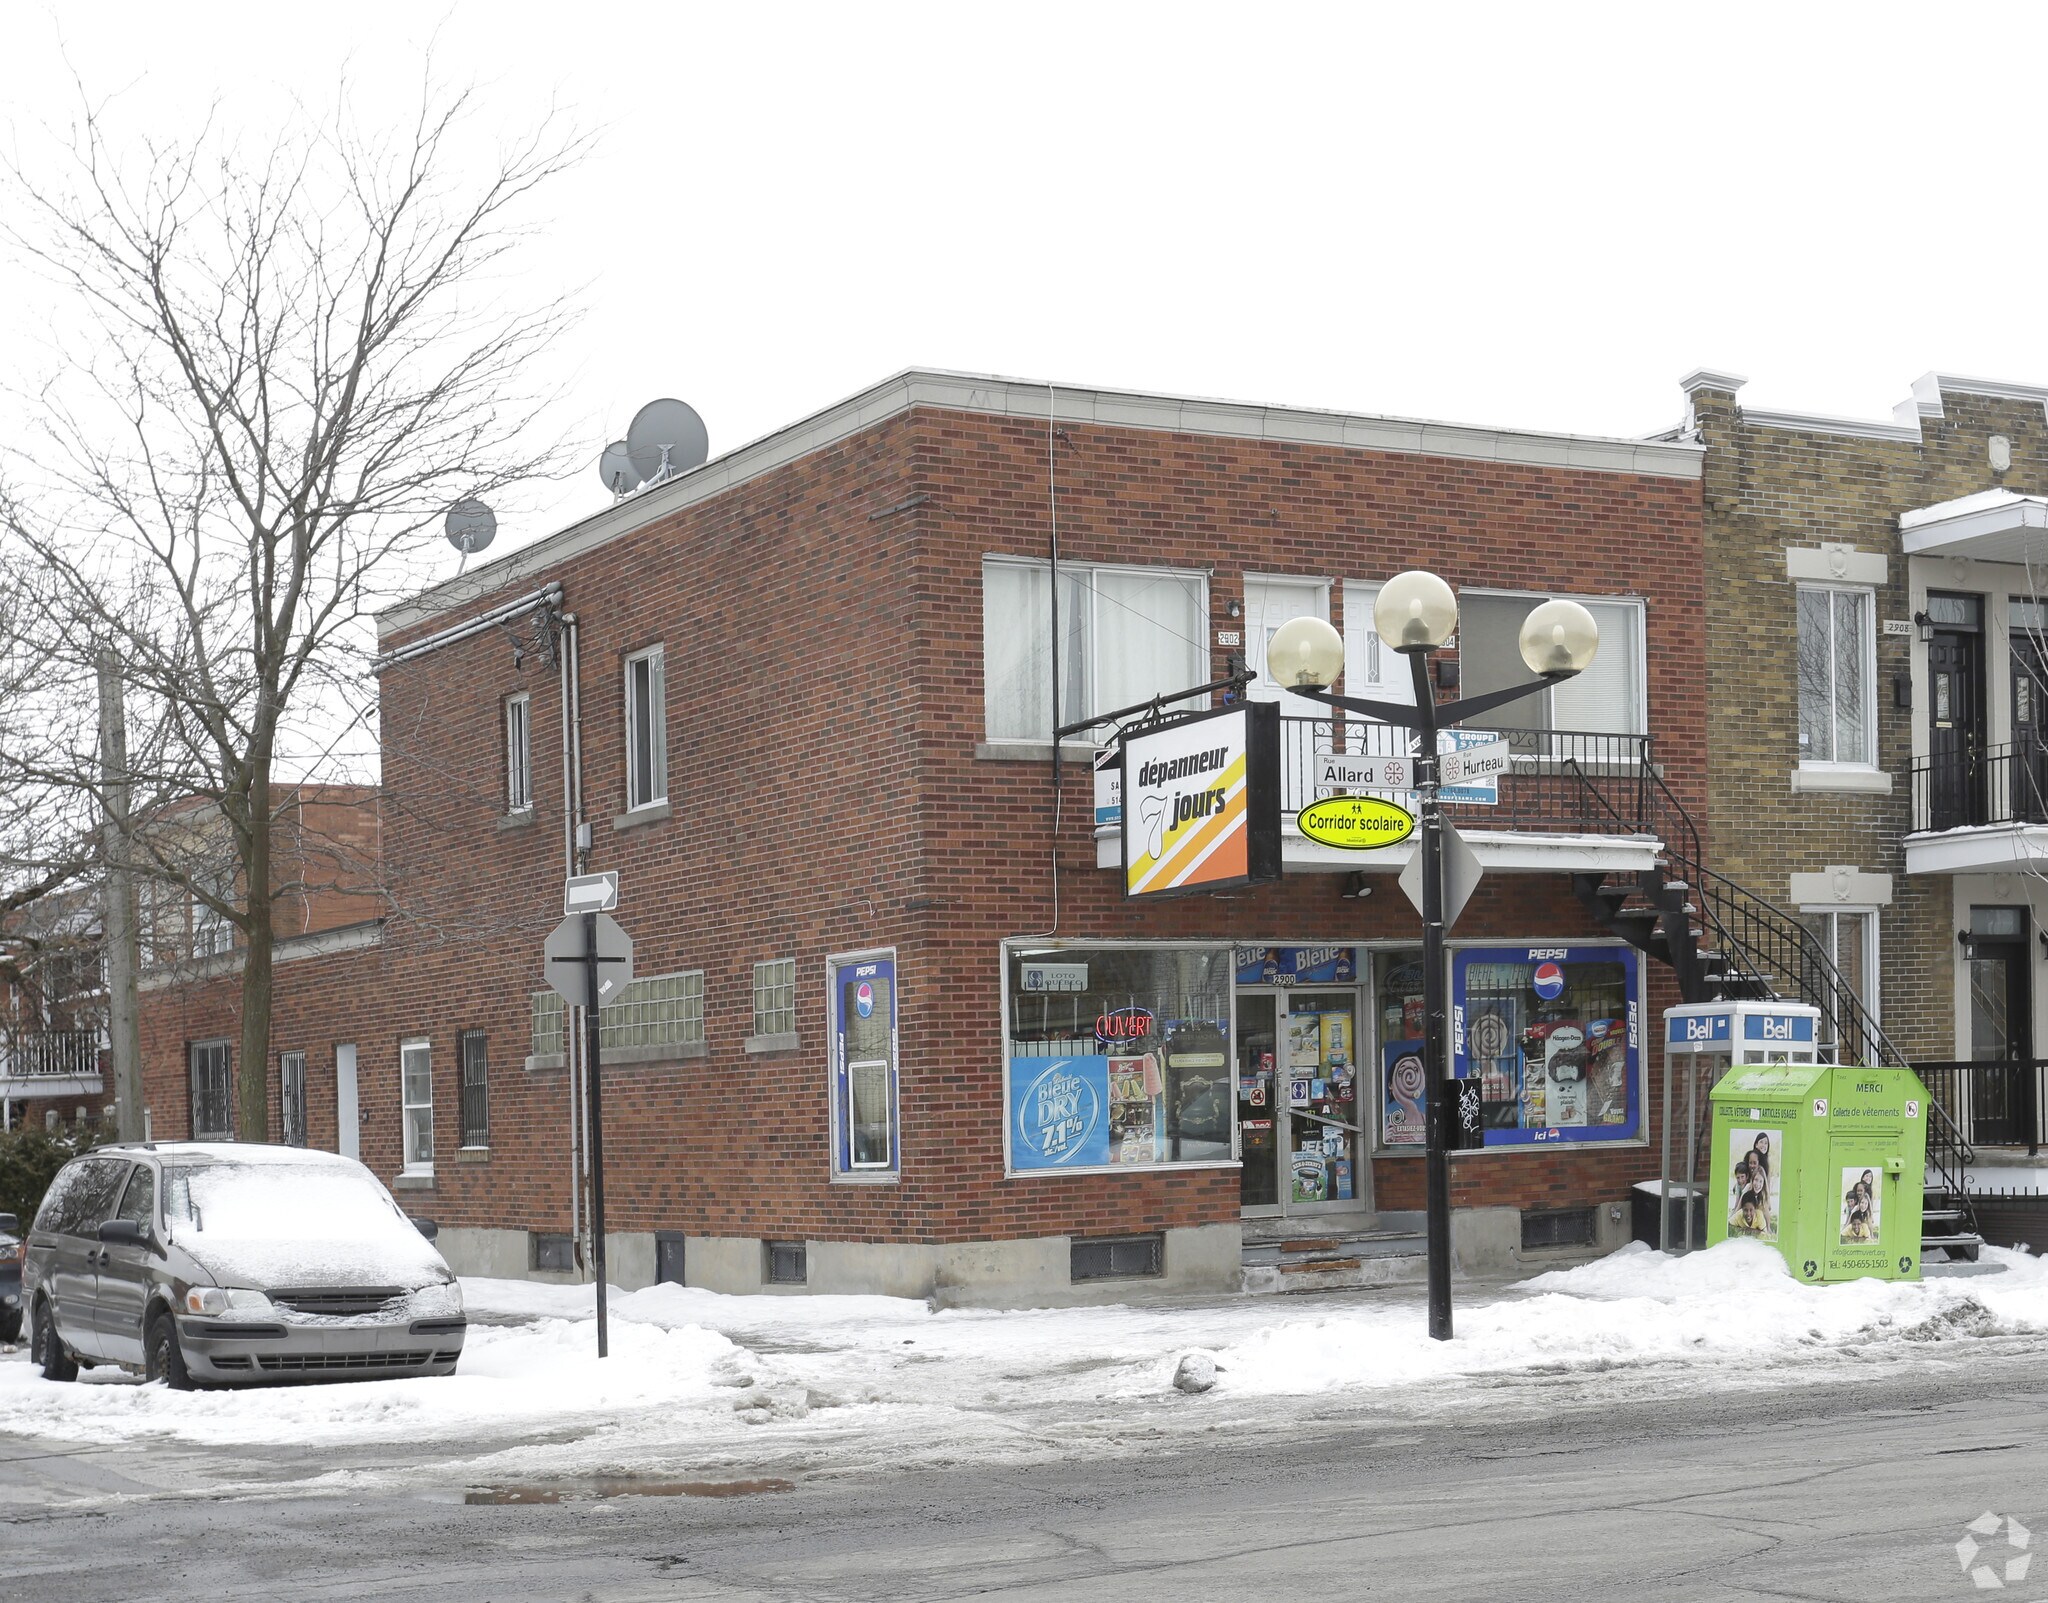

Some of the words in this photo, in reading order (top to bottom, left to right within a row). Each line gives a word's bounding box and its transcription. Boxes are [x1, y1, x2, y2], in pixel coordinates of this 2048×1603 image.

[1888, 623, 1910, 632] 2908
[1219, 632, 1238, 644] 2902
[1459, 733, 1494, 742] GROUPE
[1139, 746, 1228, 788] dépanneur
[1324, 766, 1373, 783] Allard
[1463, 757, 1503, 776] Hurteau
[1140, 795, 1168, 860] 7
[1169, 787, 1226, 832] jours
[1308, 813, 1356, 830] Corridor
[1359, 815, 1404, 831] scolaire
[1528, 948, 1568, 960] PEPSI
[856, 965, 877, 977] PEPSI
[1274, 975, 1295, 983] 2900
[1096, 1015, 1153, 1036] OUVERT
[1454, 1005, 1464, 1055] PEPSI
[1628, 1000, 1638, 1048] PEPSI
[1687, 1017, 1713, 1040] Bell
[1763, 1017, 1793, 1040] Bell
[1038, 1077, 1081, 1102] Bleue
[1856, 1083, 1883, 1093] MERCI
[1038, 1088, 1082, 1127] DRY
[1762, 1108, 1780, 1119] ARTICLES
[1833, 1107, 1851, 1117] Collecte
[1851, 1107, 1860, 1117] de
[1863, 1107, 1900, 1117] vêtements
[1042, 1116, 1083, 1150] 7.1%
[1534, 1131, 1546, 1141] ici
[1842, 1259, 1888, 1269] 450-655-1503
